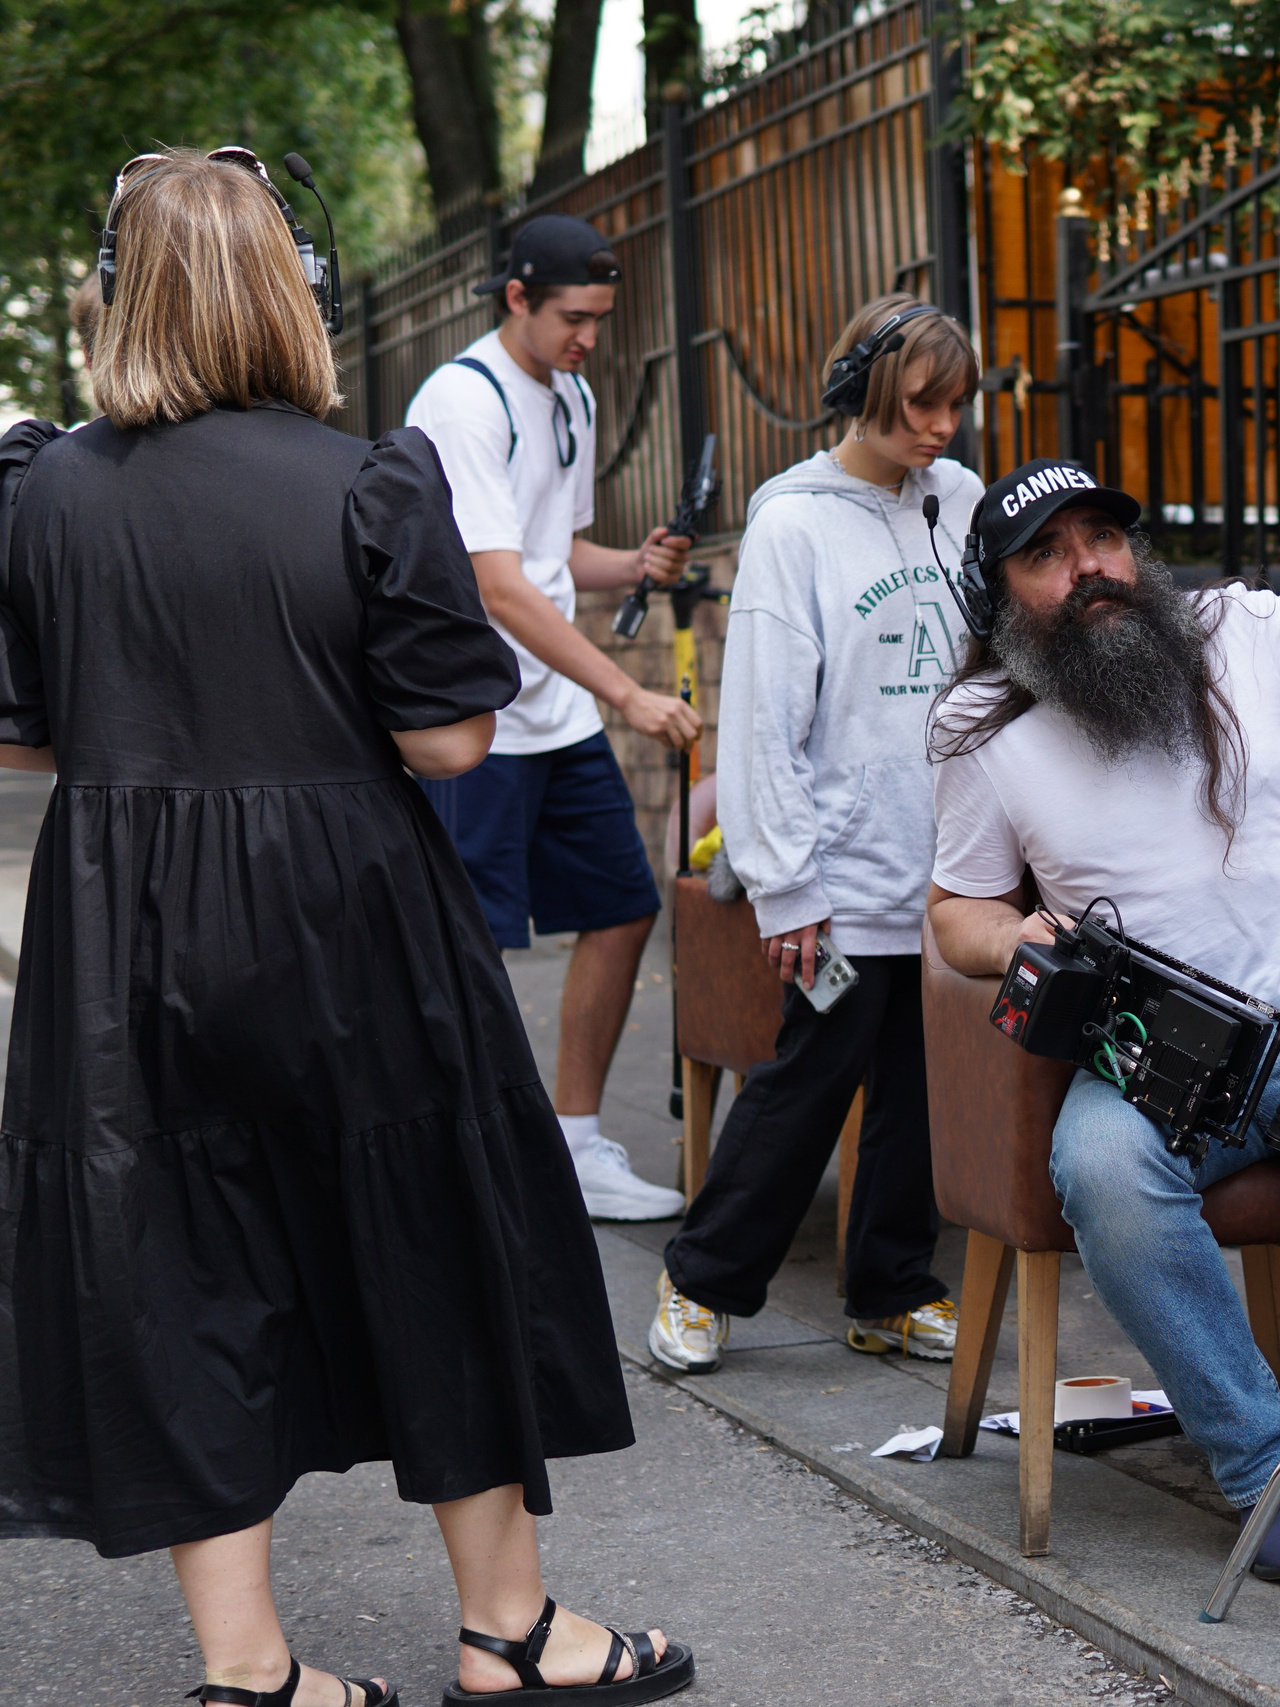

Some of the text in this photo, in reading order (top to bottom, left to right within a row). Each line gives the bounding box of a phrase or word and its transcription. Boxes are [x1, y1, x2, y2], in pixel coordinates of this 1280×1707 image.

[1001, 466, 1097, 518] CANNES
[854, 565, 940, 621] ATHLETCS
[878, 633, 905, 644] GAME
[879, 685, 907, 697] YOUR
[910, 685, 930, 695] WAY
